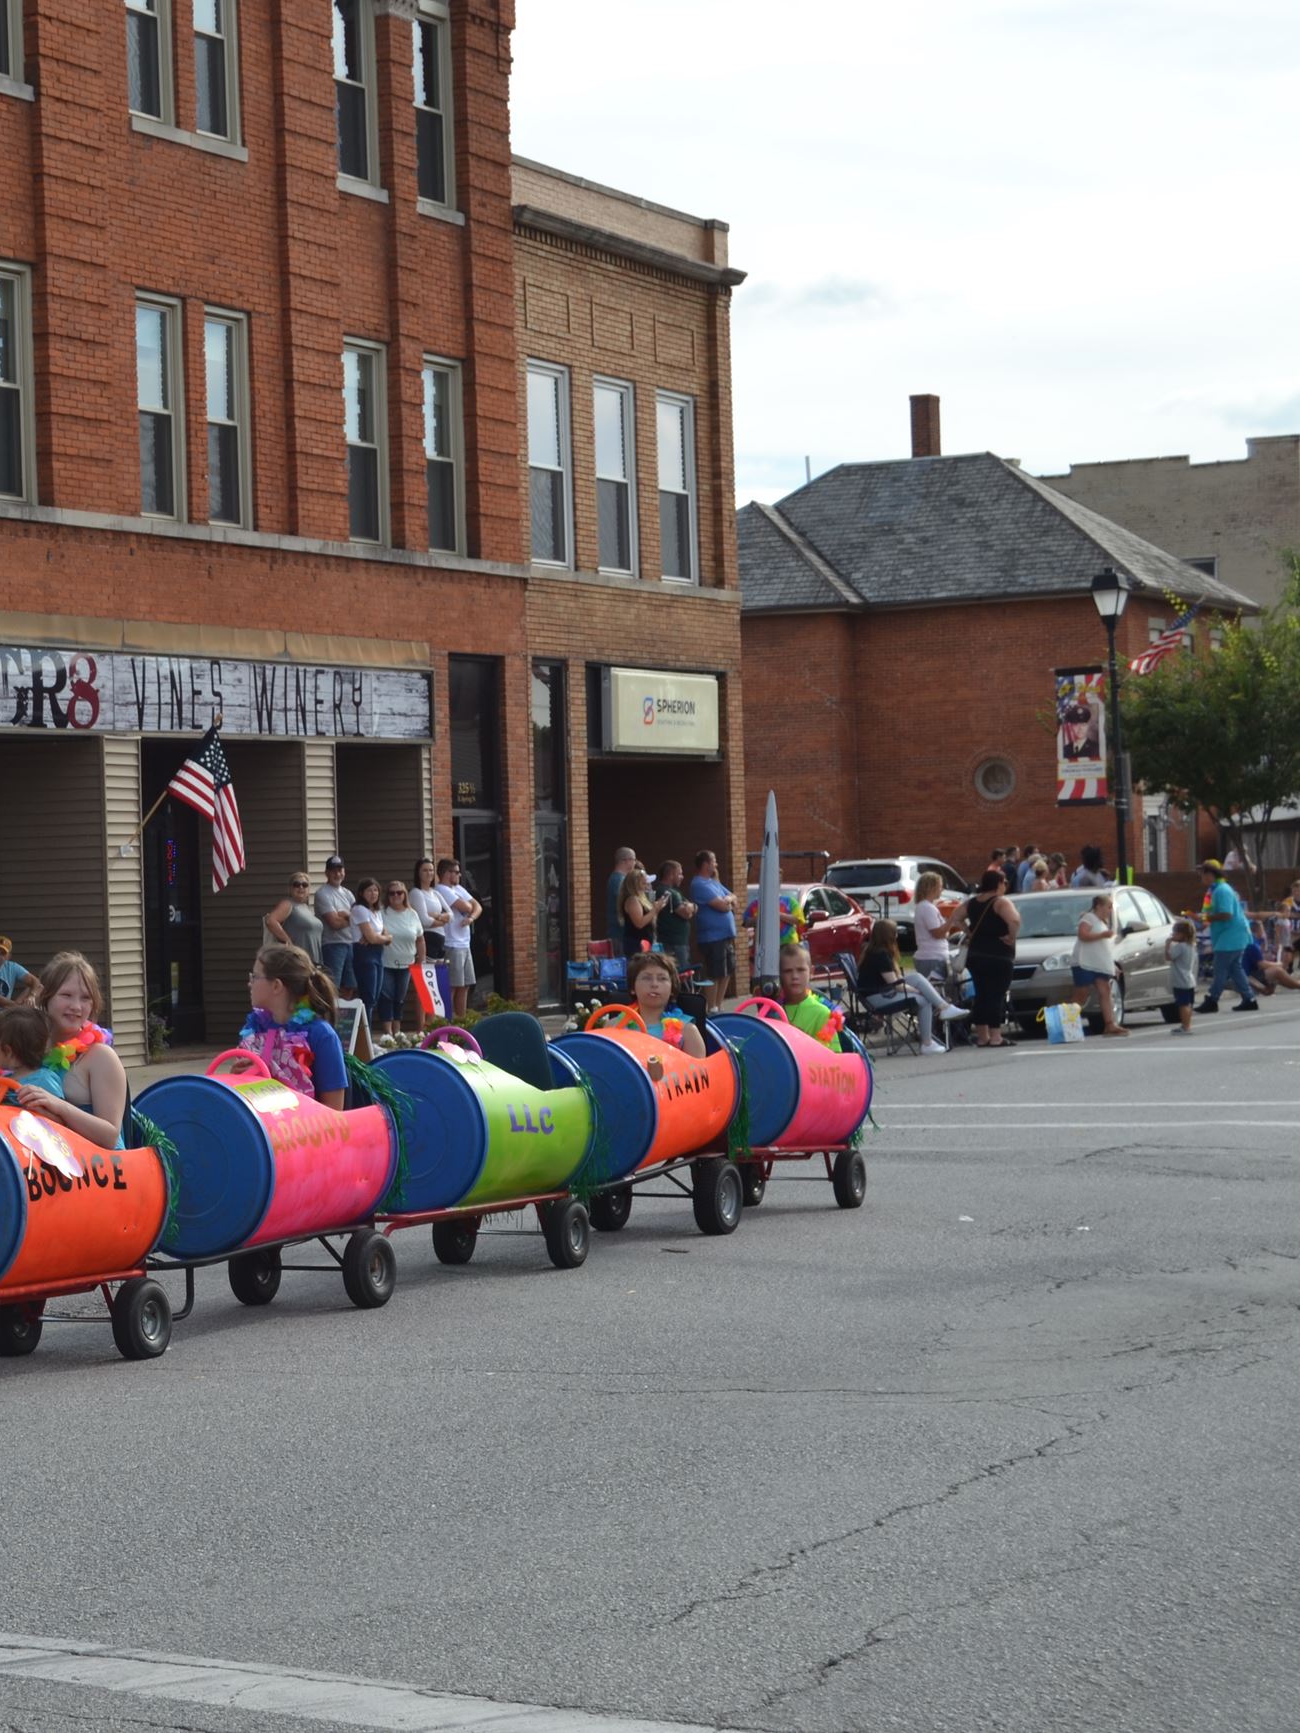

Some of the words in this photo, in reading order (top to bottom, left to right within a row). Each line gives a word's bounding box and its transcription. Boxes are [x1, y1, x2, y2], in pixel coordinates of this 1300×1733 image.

[130, 657, 224, 731] VINES
[252, 664, 365, 737] WINERY
[656, 699, 696, 715] SPHERION
[663, 1064, 709, 1101] TRAIN
[808, 1062, 856, 1096] STATION
[271, 1111, 350, 1156] AROUND
[509, 1103, 554, 1135] LLC
[23, 1154, 128, 1202] BOUNCE
